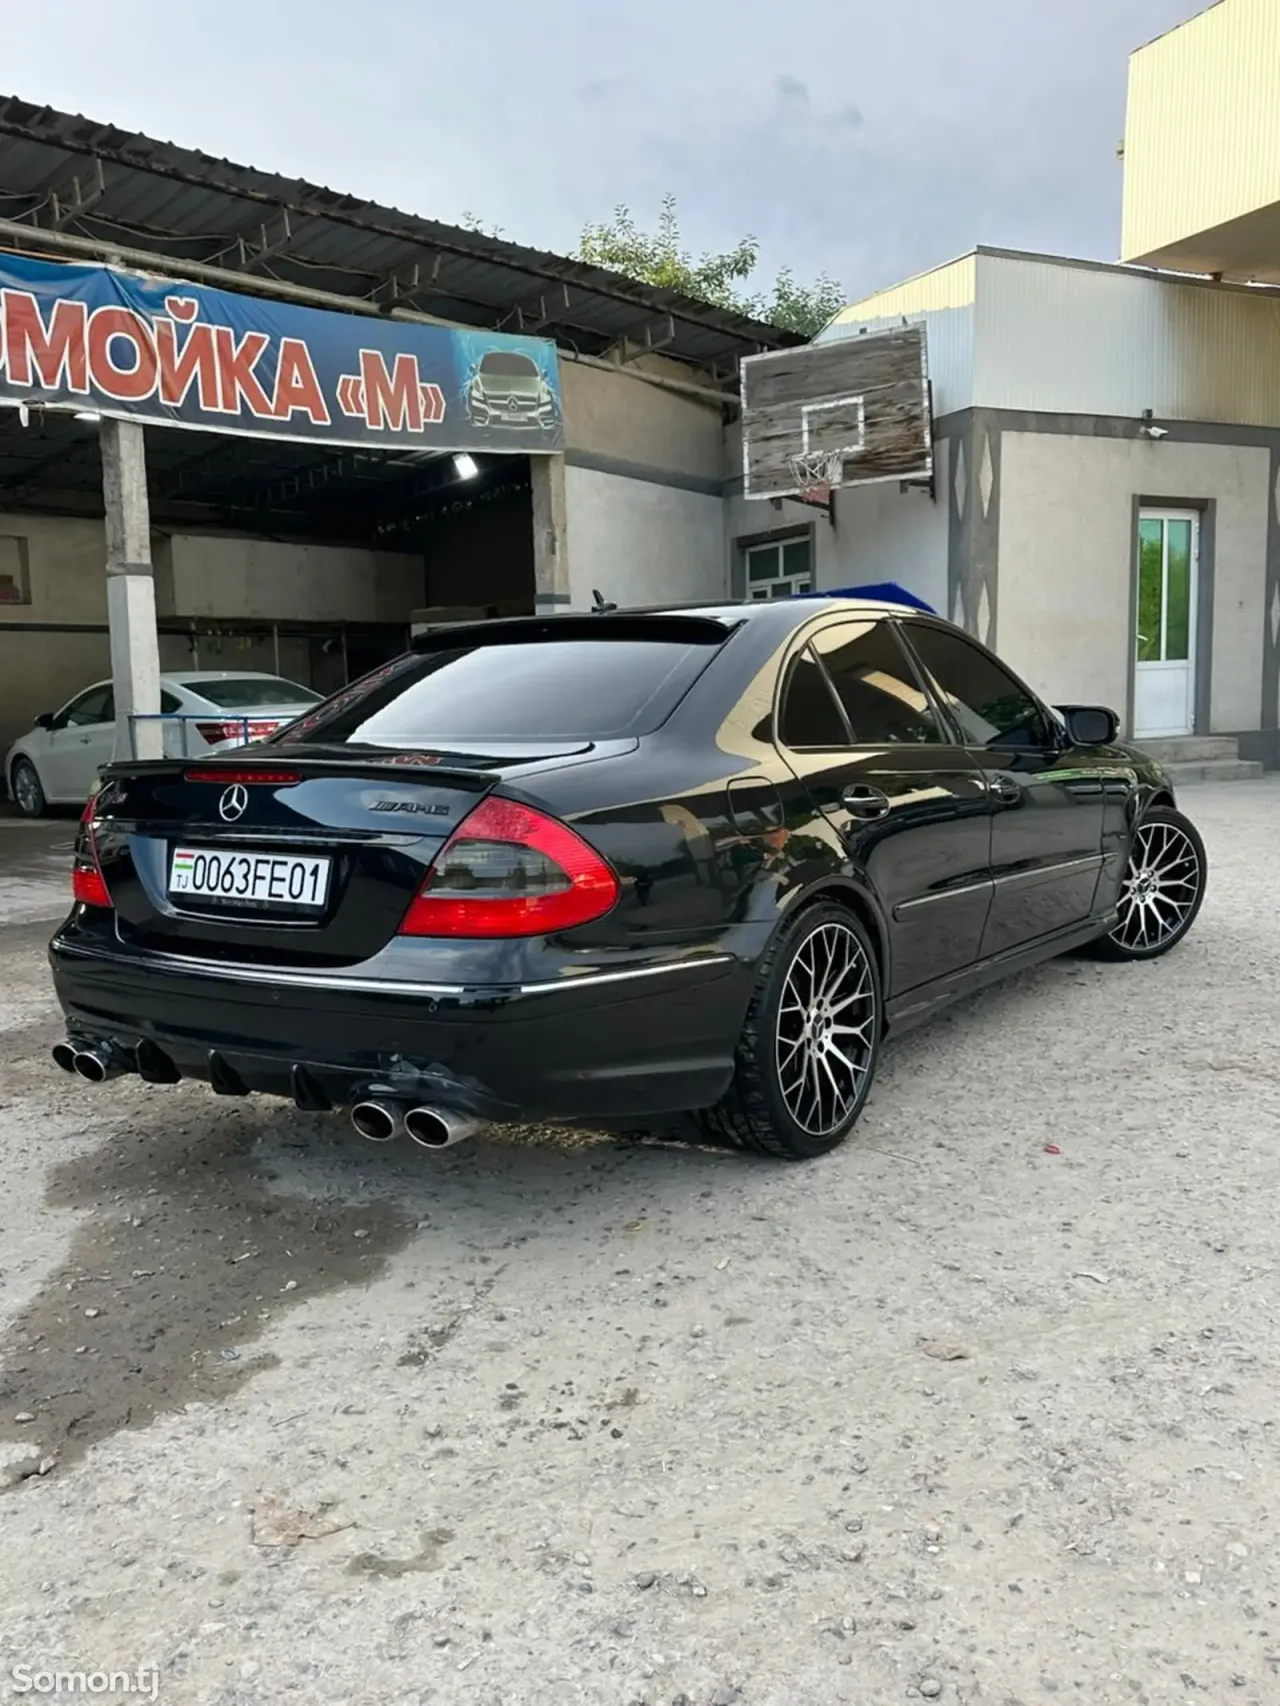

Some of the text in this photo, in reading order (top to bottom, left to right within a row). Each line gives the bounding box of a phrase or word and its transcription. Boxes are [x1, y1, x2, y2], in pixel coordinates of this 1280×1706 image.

[0, 288, 446, 433] МОЙКА «М»
[176, 874, 190, 889] TJ
[192, 854, 320, 902] 0063FE01
